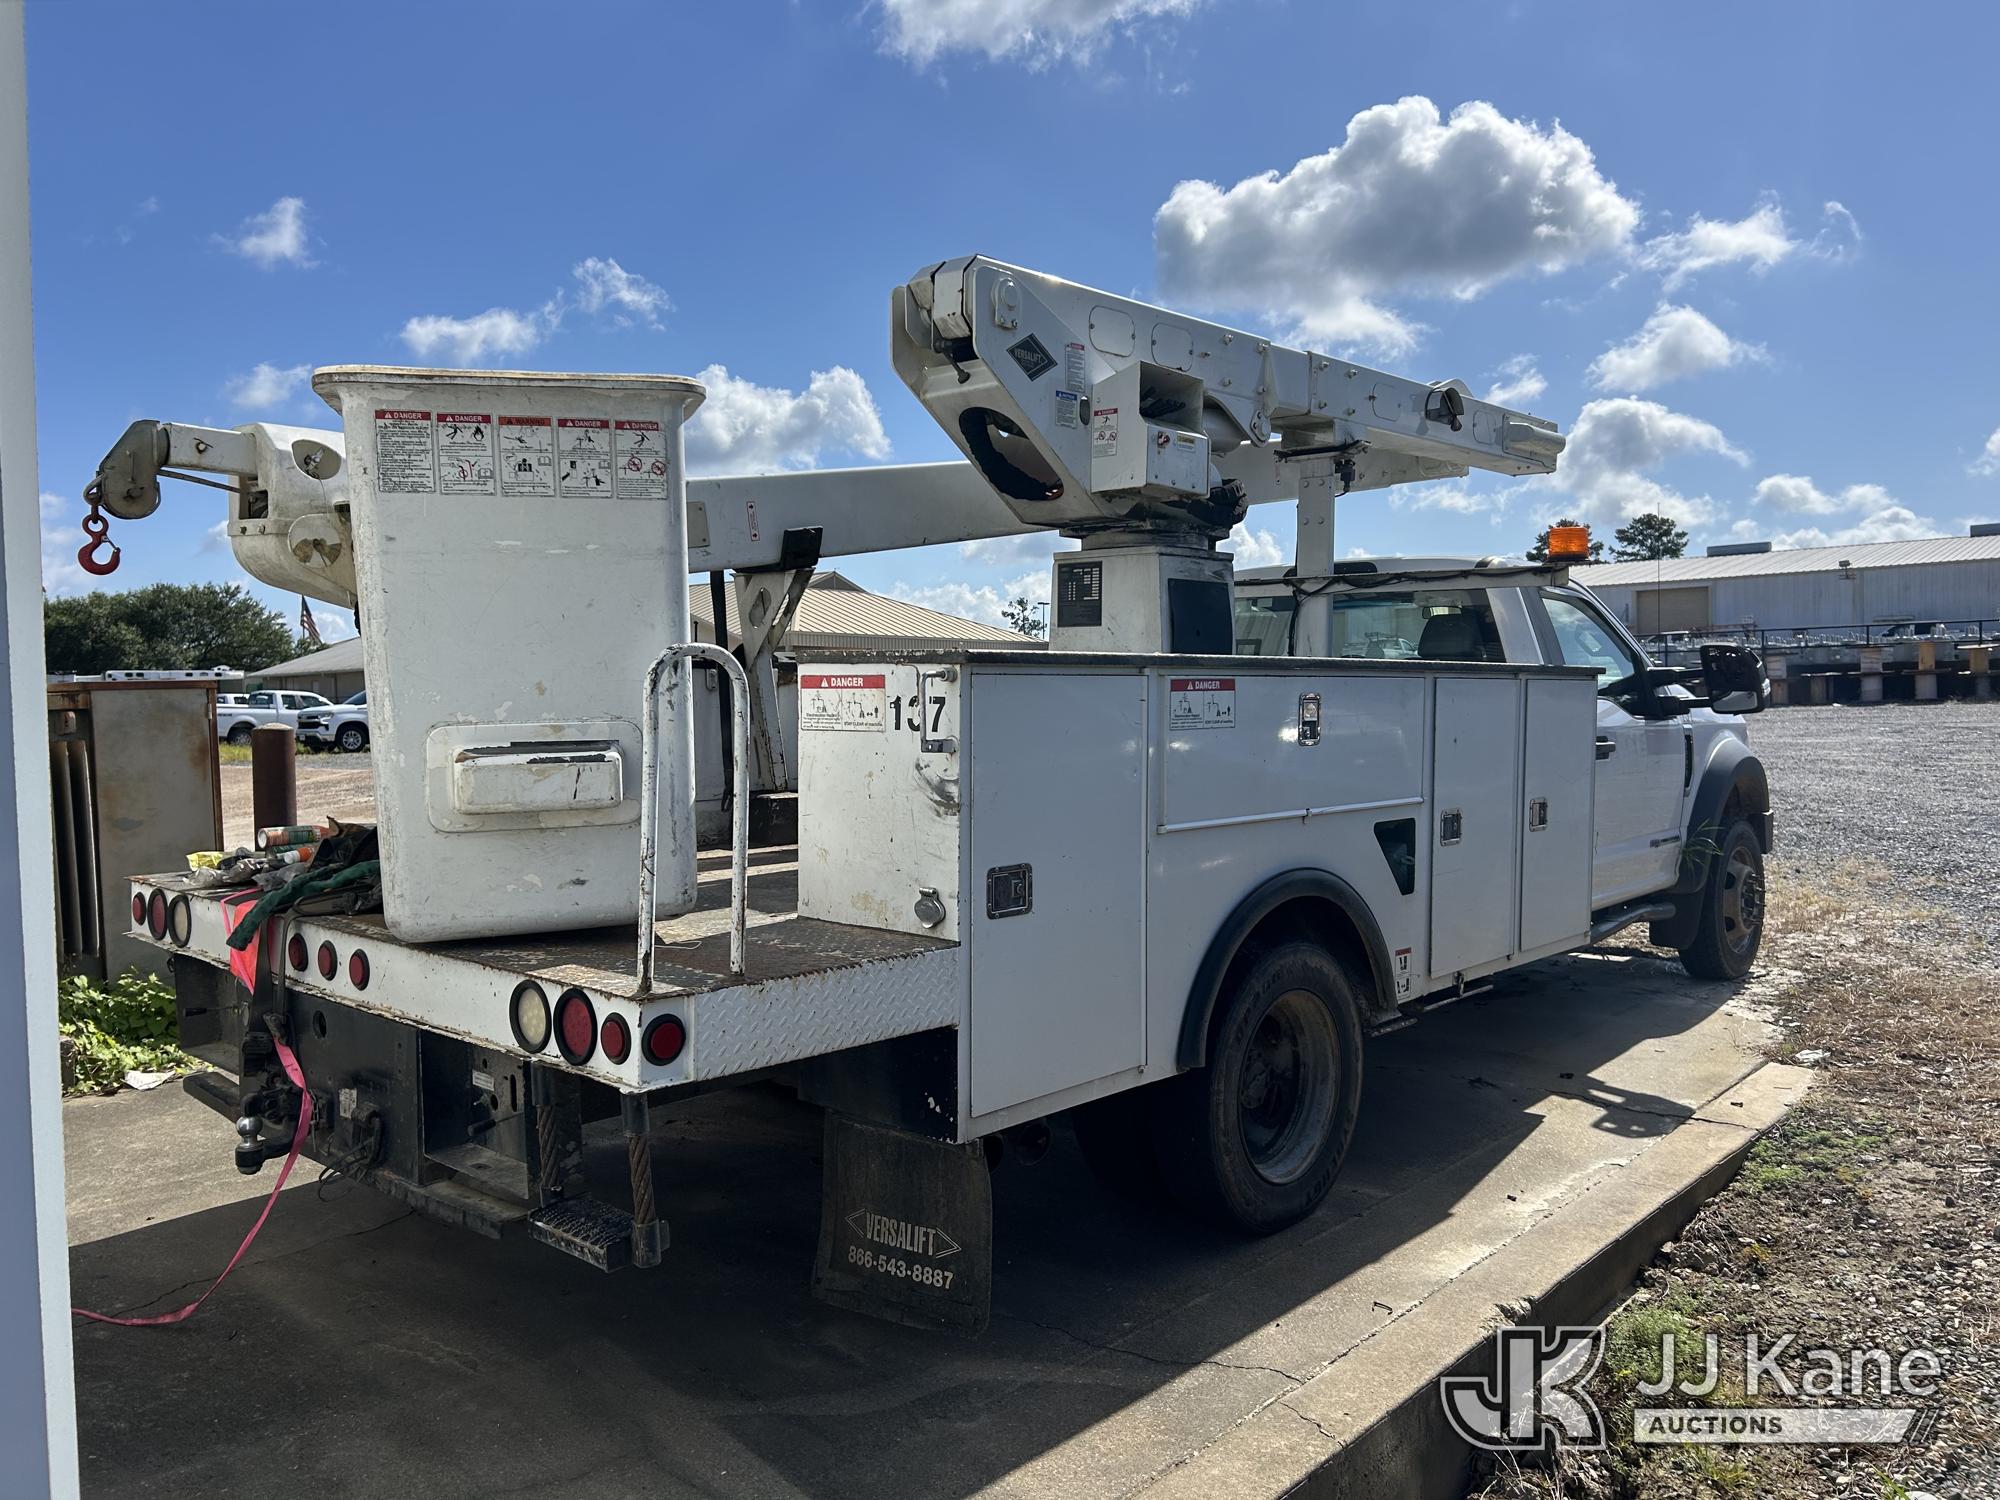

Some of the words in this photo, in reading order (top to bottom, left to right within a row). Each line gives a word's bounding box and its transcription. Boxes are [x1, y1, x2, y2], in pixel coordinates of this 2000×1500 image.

[393, 412, 423, 420] DANGER
[574, 420, 601, 428] DANGER
[830, 677, 864, 687] DANGER
[1194, 680, 1221, 690] DANGER
[889, 695, 946, 733] 137
[866, 1212, 936, 1256] VERSALIFT
[848, 1245, 954, 1289] 866-543-8887
